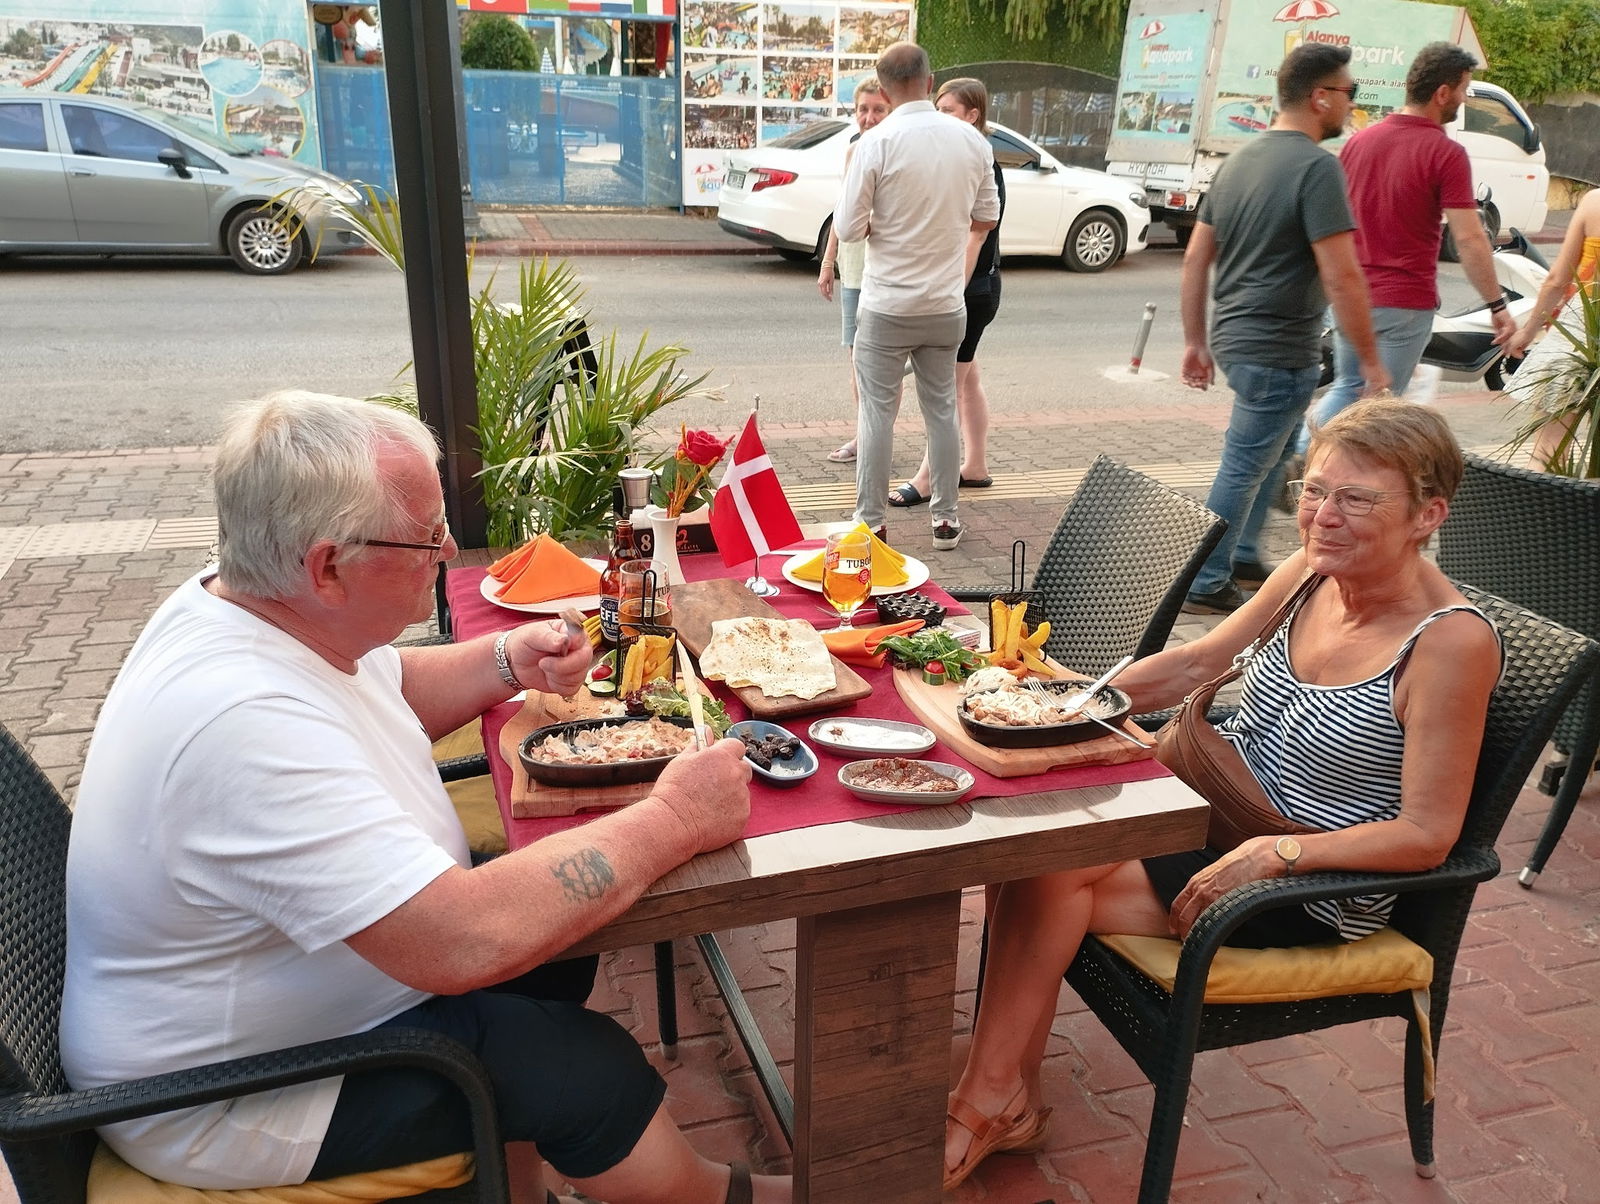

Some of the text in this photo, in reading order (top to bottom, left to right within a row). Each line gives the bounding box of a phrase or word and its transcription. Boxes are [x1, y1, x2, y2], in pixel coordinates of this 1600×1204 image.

[1306, 30, 1350, 45] Alanya
[1350, 45, 1405, 65] park
[1354, 77, 1407, 88] quapark alan
[1355, 91, 1378, 100] .com
[641, 534, 651, 551] 8
[600, 606, 619, 623] EFE
